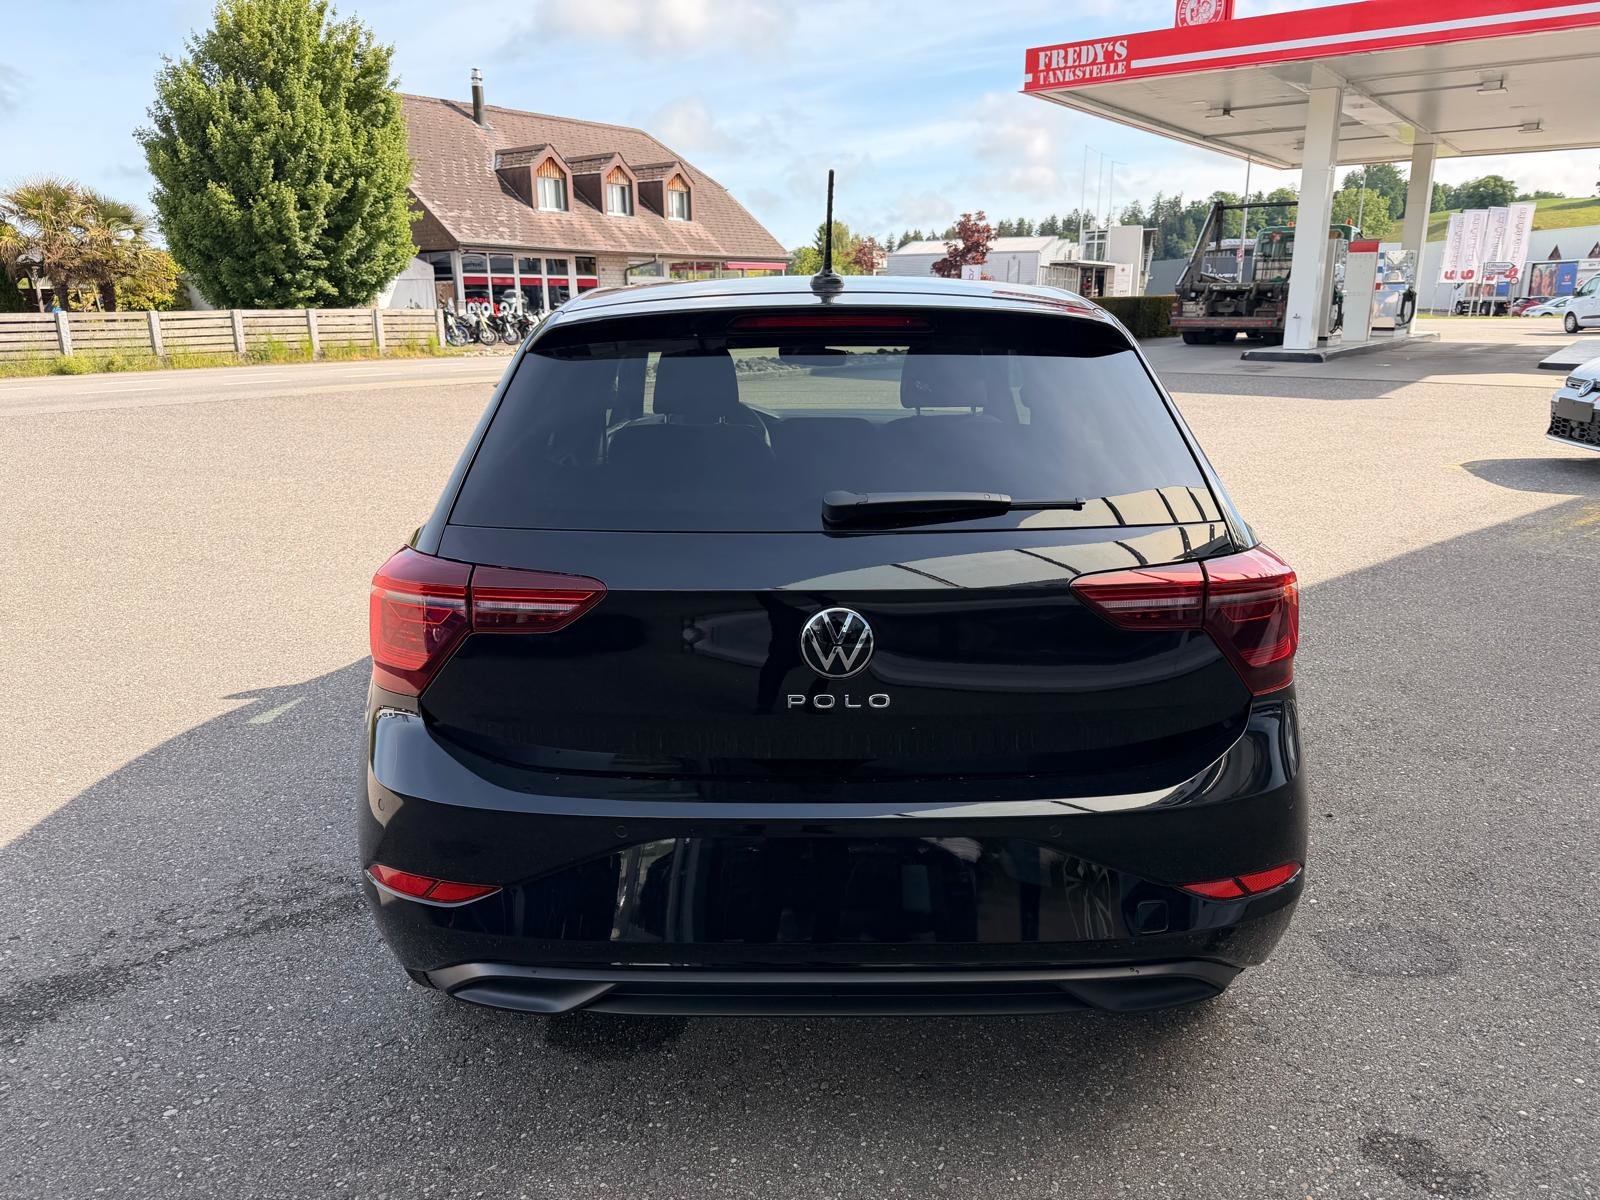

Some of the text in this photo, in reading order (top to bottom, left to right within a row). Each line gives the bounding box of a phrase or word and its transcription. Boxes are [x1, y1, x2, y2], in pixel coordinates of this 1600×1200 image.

[1038, 40, 1128, 70] FREDY'S
[1038, 62, 1127, 85] TANKSTELLE
[787, 693, 891, 709] POLO
